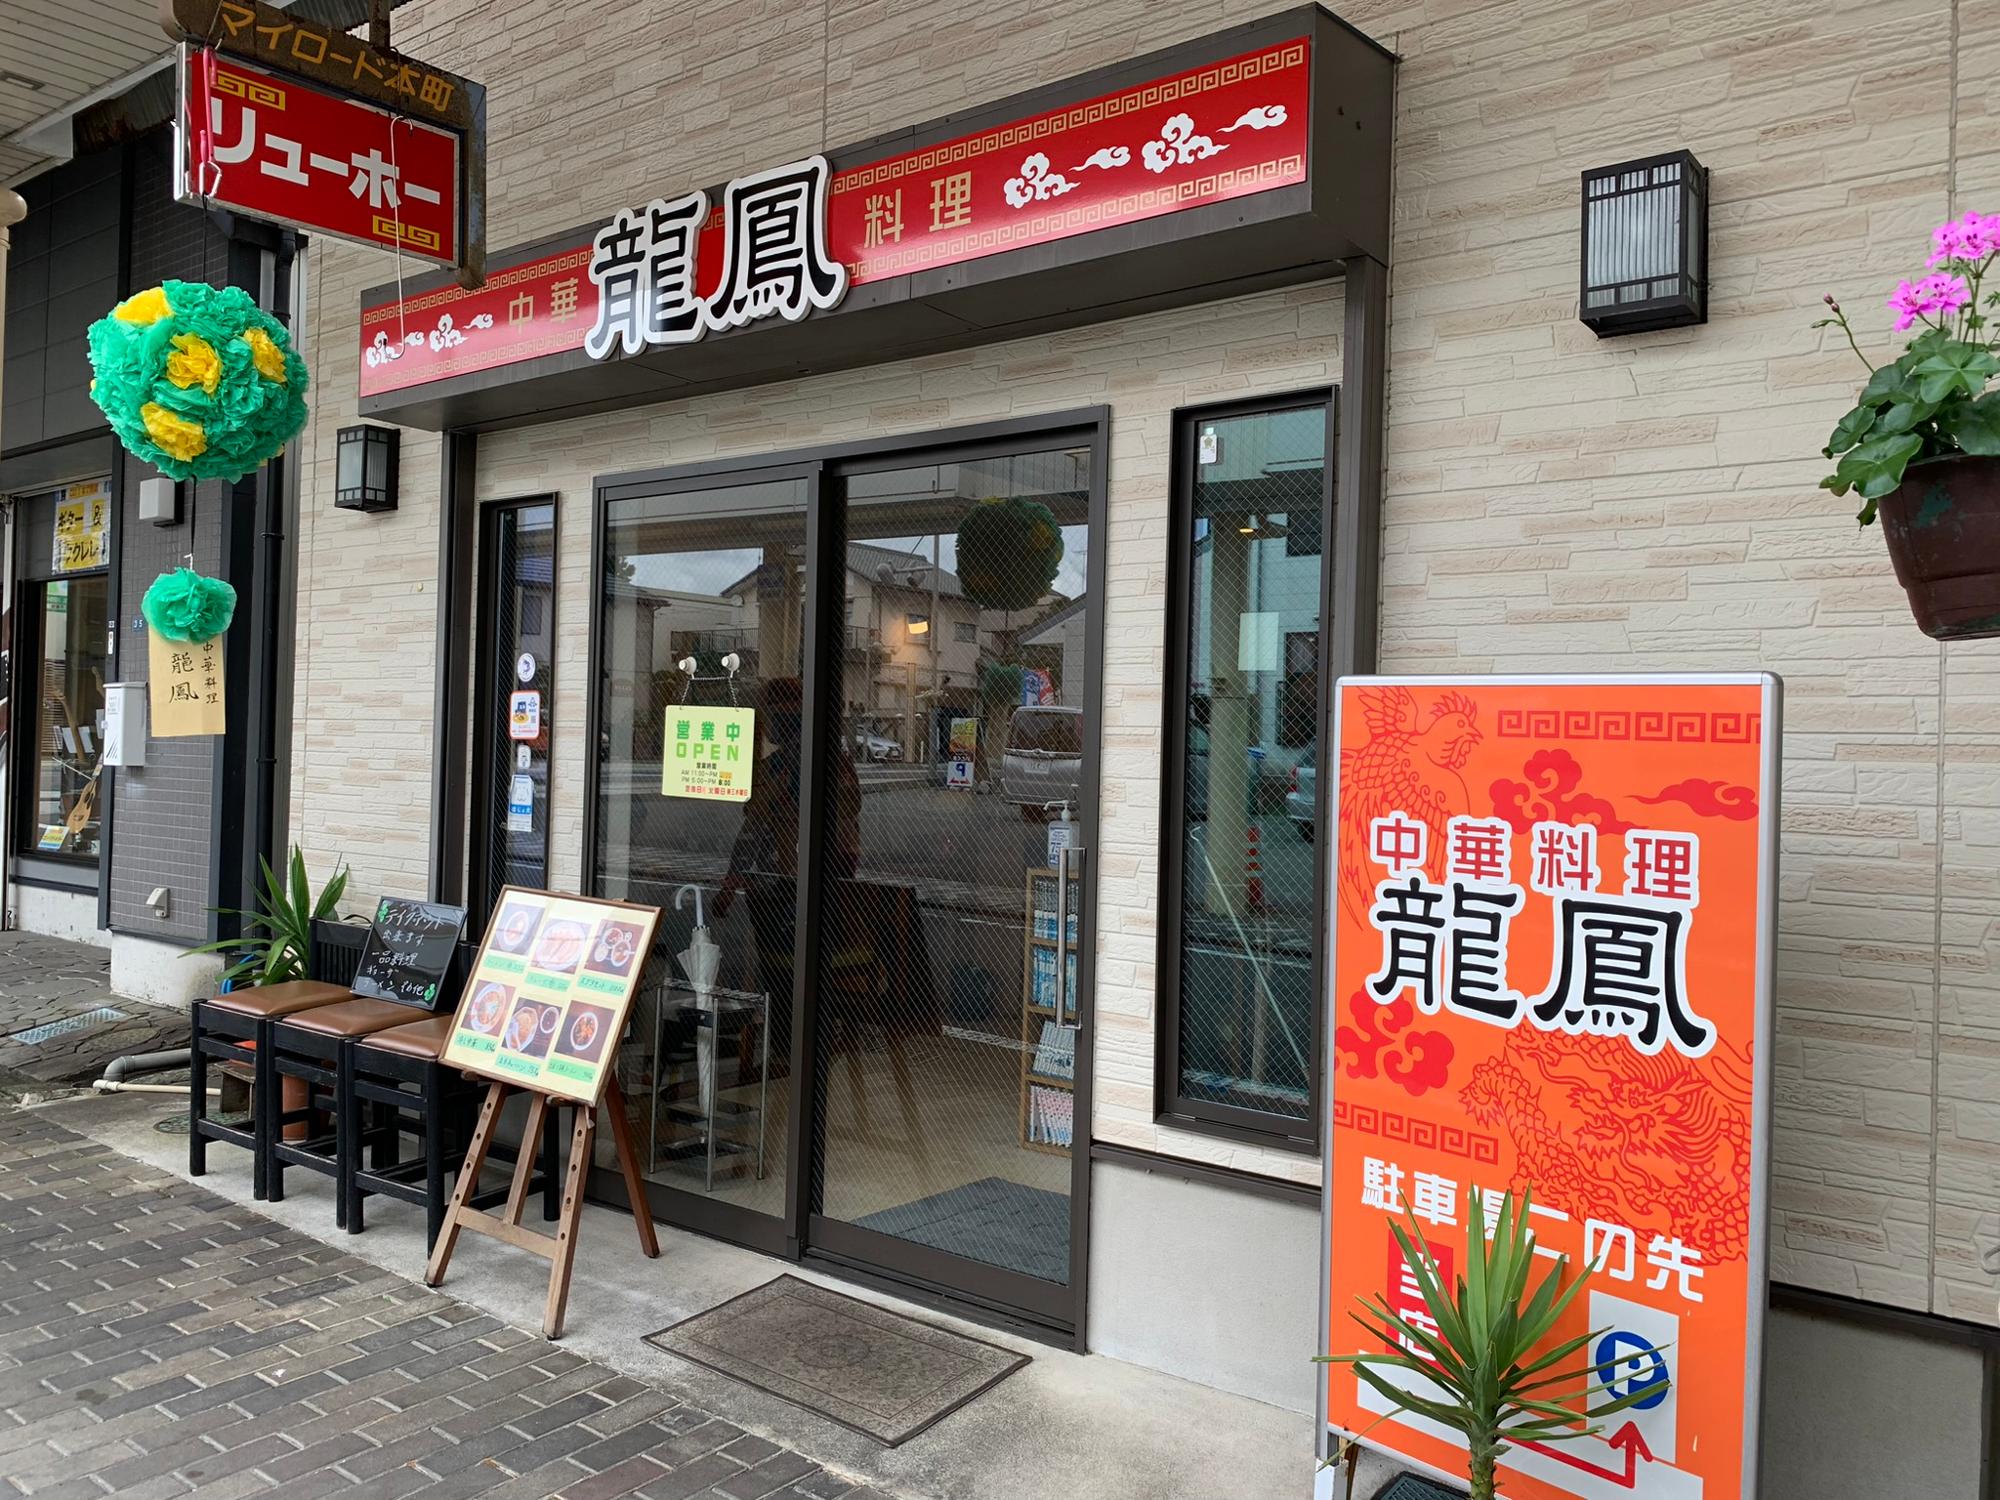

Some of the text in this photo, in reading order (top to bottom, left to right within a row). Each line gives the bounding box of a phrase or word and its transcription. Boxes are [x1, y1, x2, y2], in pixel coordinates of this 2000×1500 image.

[221, 1, 455, 112] マイロード本町
[210, 97, 441, 210] リューホー
[508, 160, 973, 357] 中華 龍鳳 料理
[169, 652, 200, 704] 龍鳳
[676, 720, 741, 742] 営業中
[676, 742, 739, 761] OPEN
[1375, 816, 1692, 901] 中華料理
[1372, 877, 1707, 1049] 龍鳳
